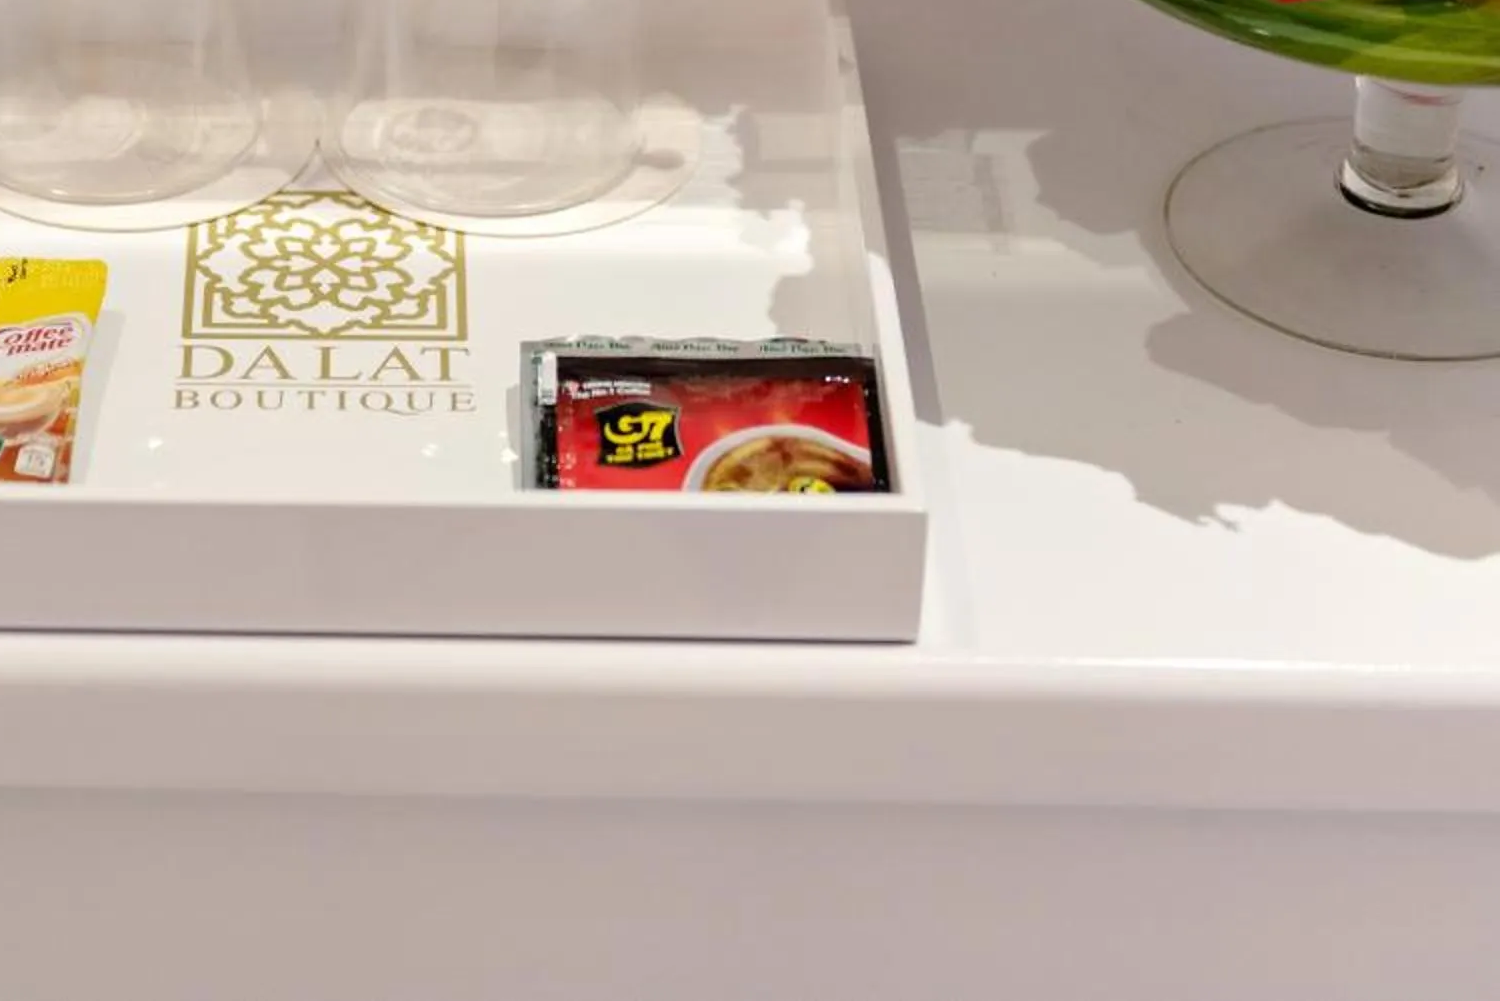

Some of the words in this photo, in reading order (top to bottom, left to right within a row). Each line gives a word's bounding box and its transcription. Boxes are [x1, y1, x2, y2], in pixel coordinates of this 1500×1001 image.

[7, 338, 73, 356] mate
[173, 387, 477, 416] BOUTIQUE
[604, 410, 673, 445] G7
